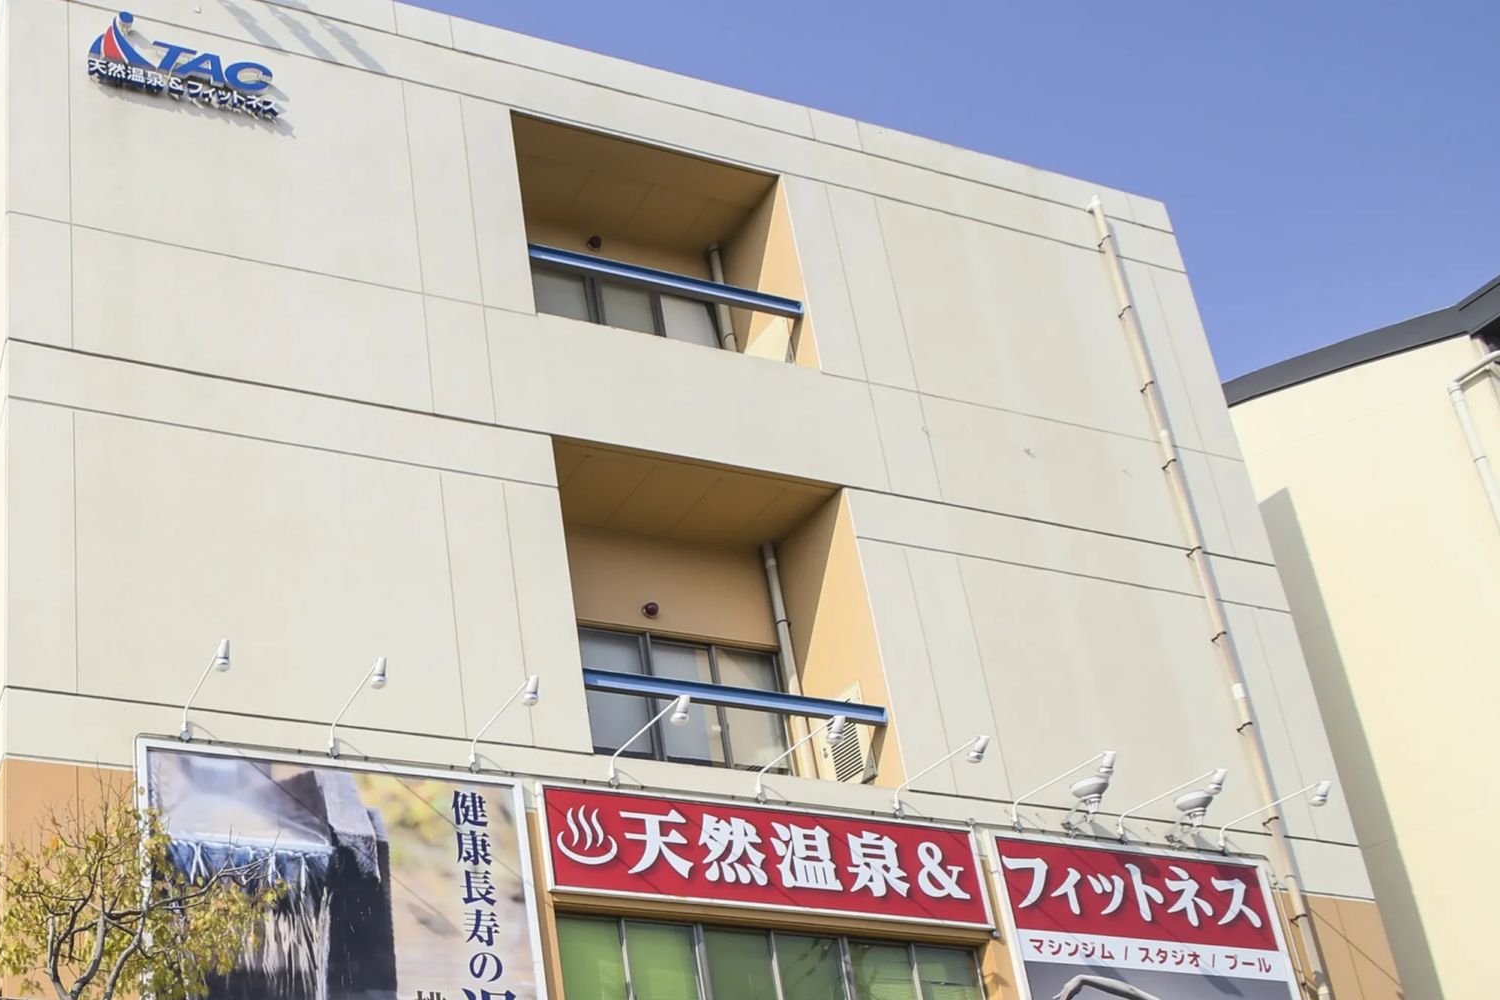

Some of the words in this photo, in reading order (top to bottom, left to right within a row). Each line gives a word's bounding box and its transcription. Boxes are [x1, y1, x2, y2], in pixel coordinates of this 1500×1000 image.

[152, 40, 274, 93] TAC
[1001, 854, 1262, 929] フィットネス
